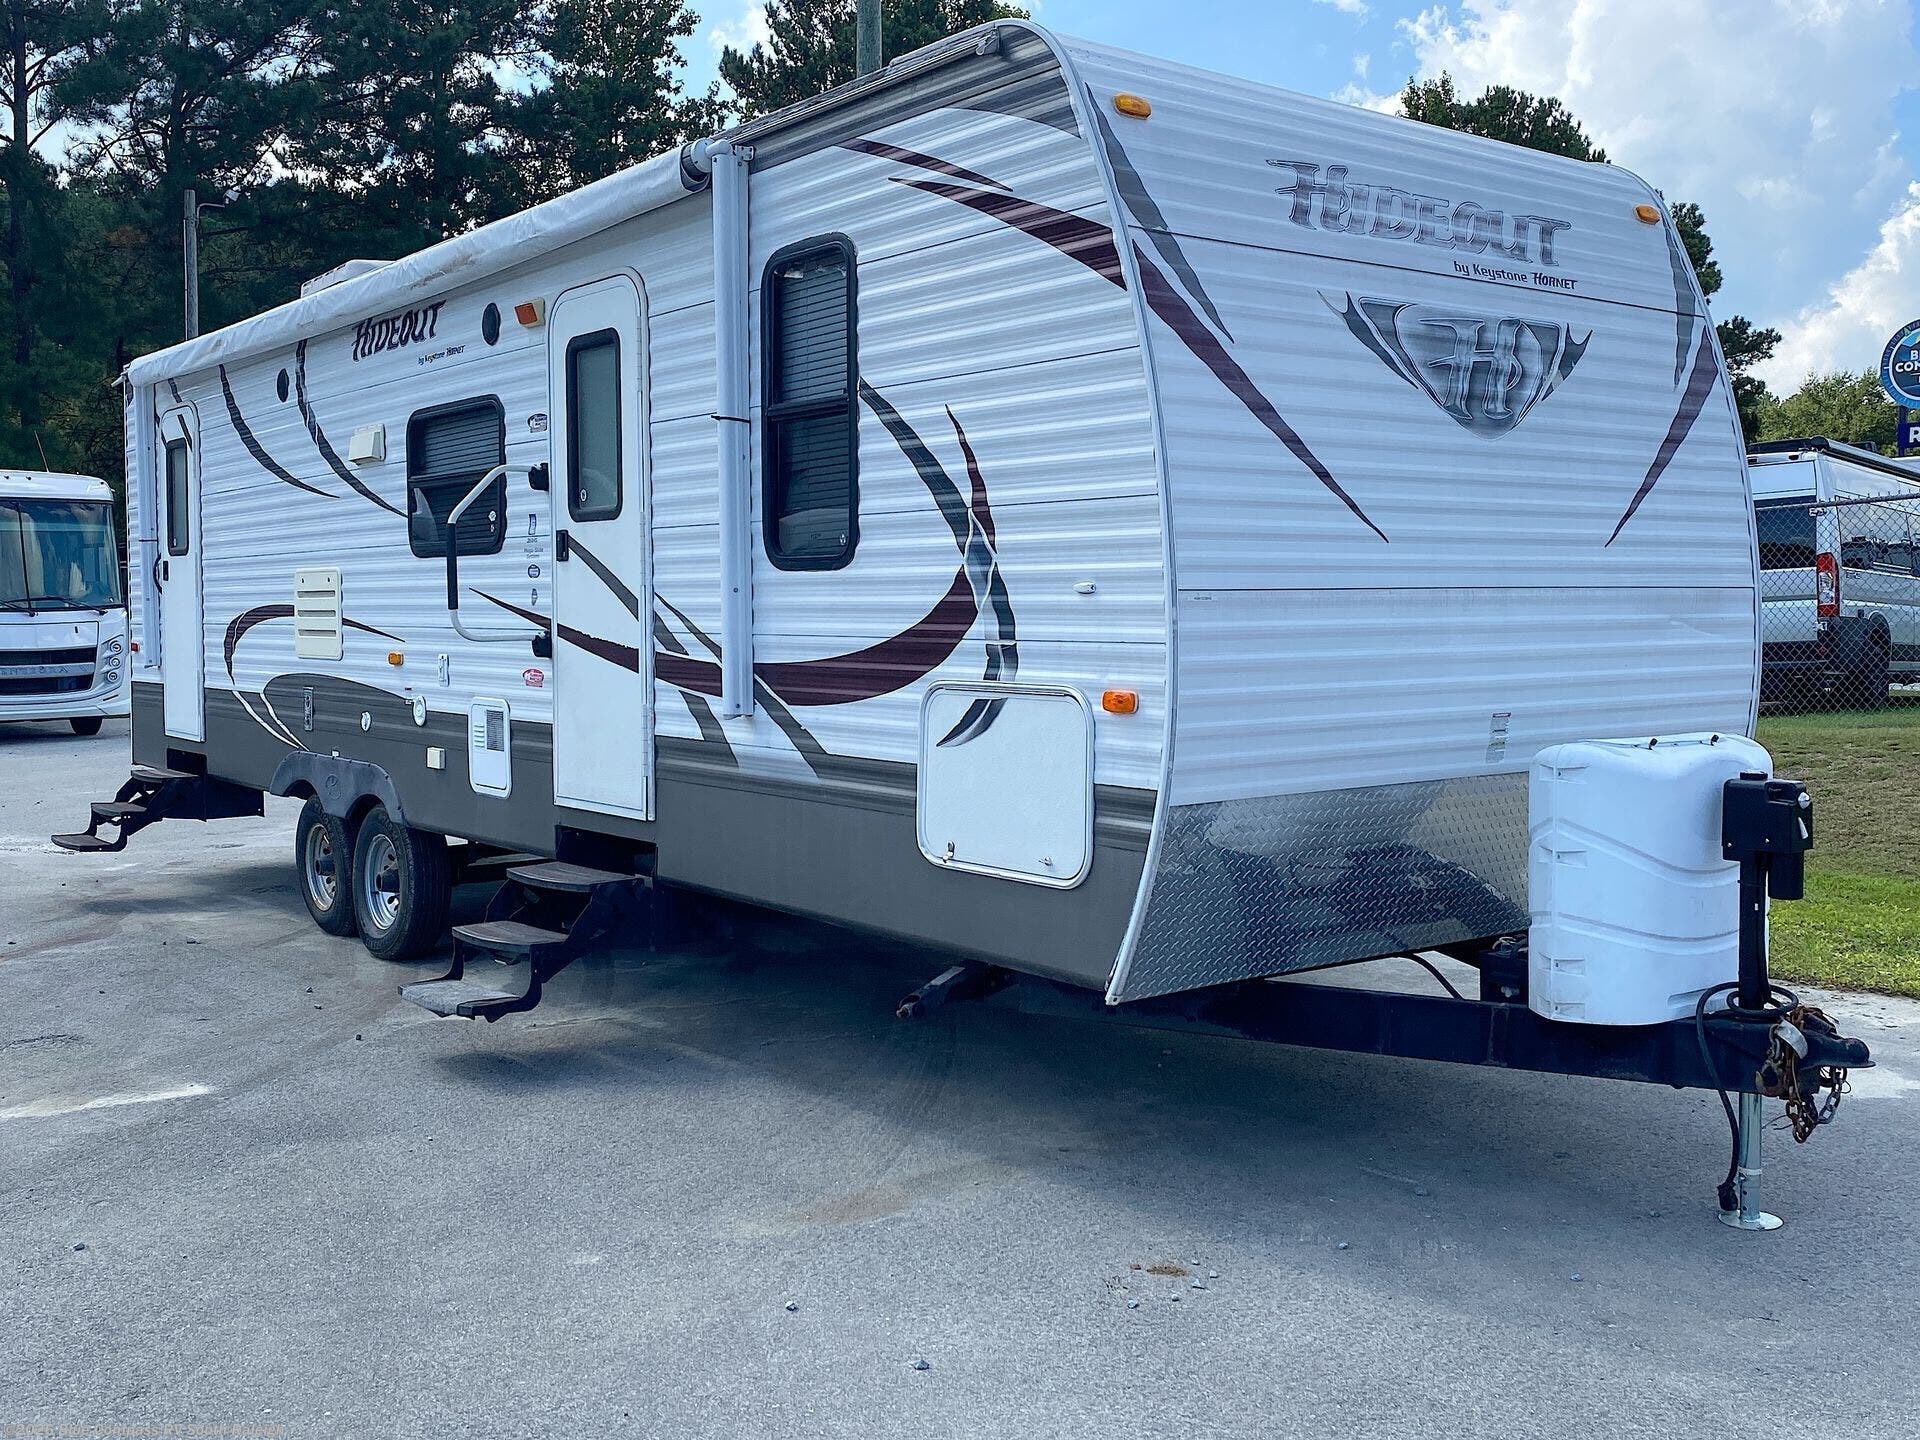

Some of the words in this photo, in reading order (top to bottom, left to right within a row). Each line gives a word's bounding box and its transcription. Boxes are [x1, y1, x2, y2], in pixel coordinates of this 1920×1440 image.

[1454, 261, 1469, 277] by
[1473, 263, 1528, 282] Keystone
[1532, 271, 1578, 290] HORNET
[1910, 349, 1920, 361] B
